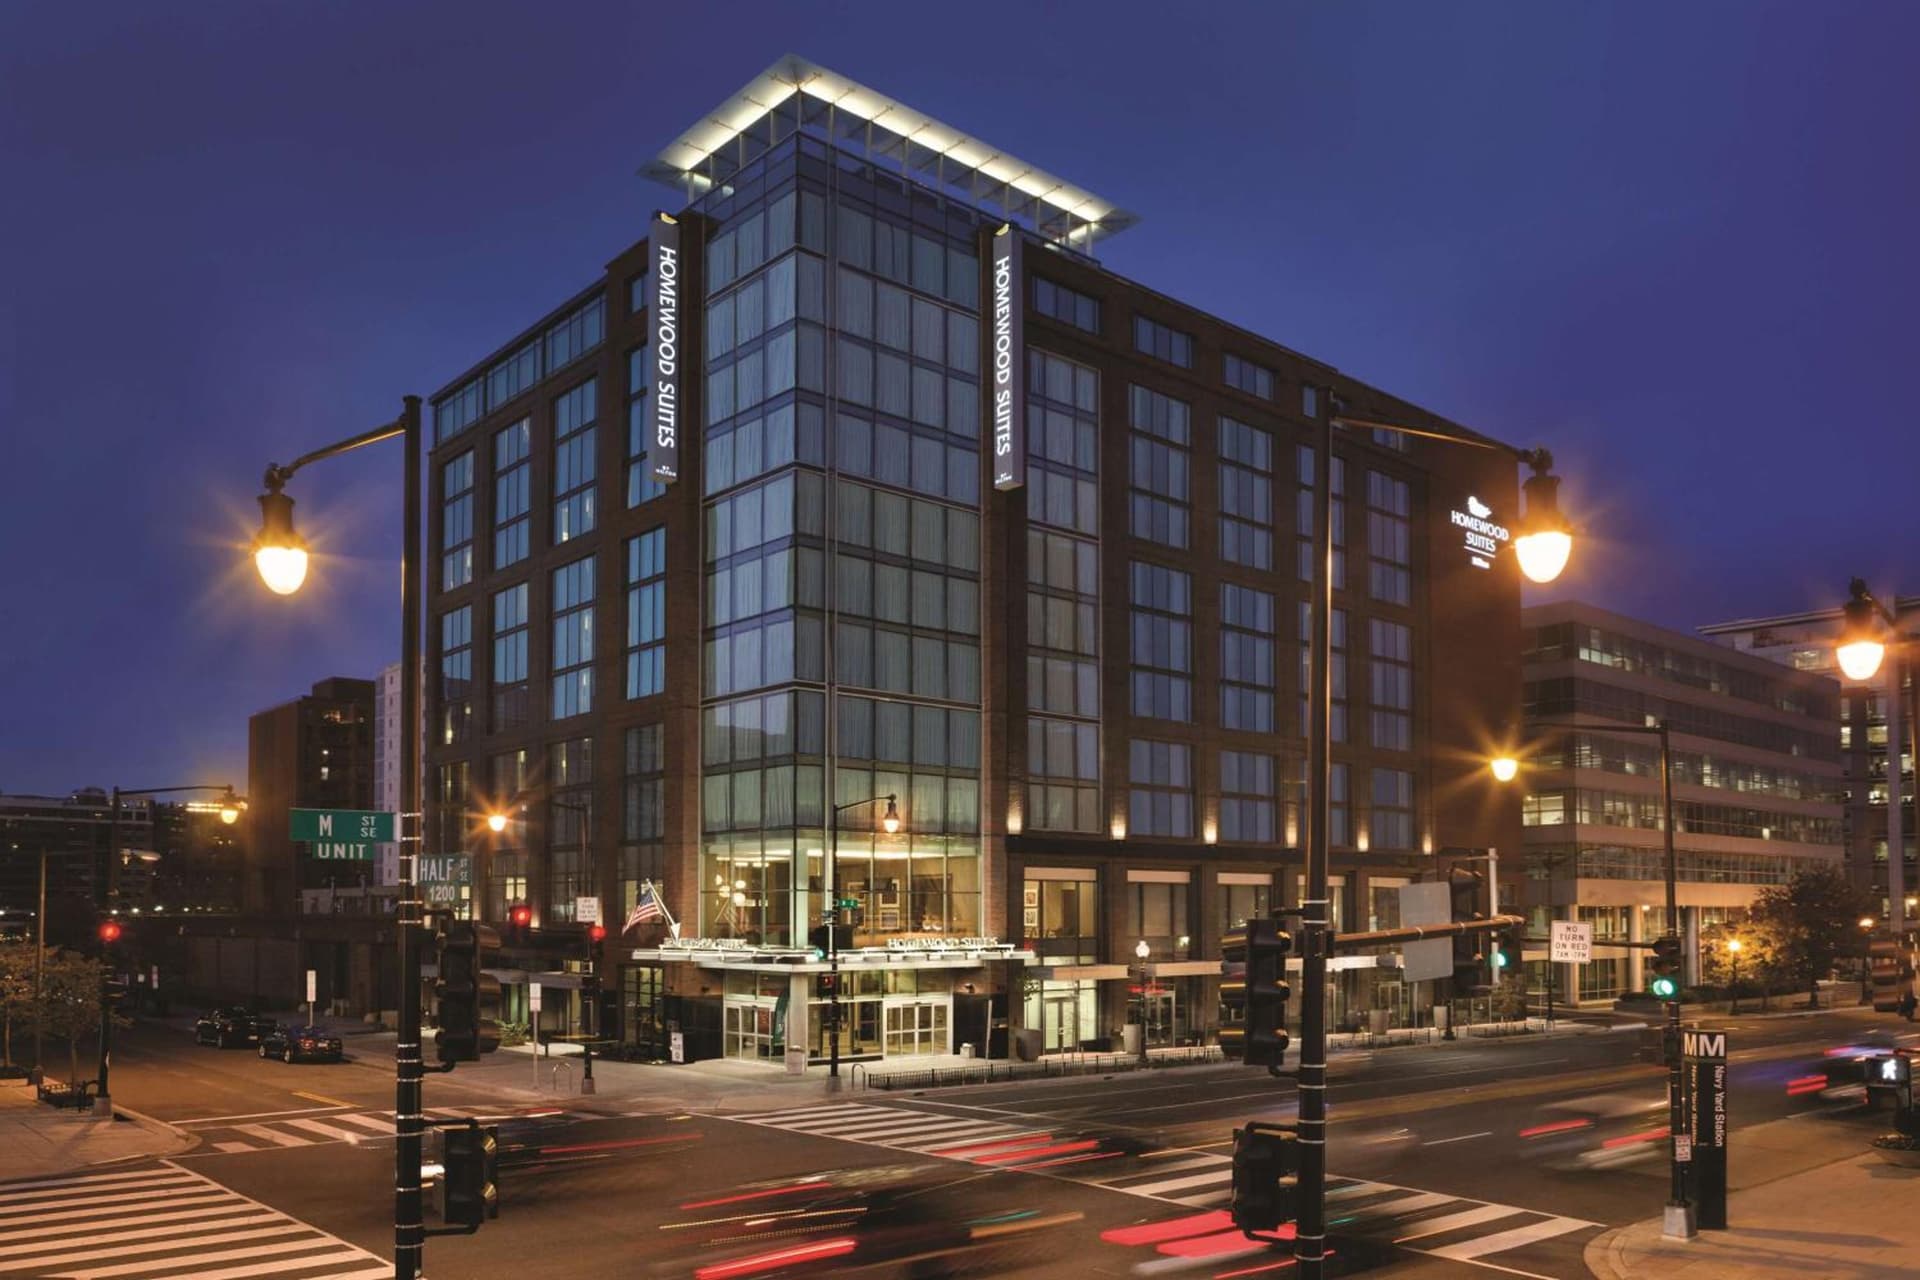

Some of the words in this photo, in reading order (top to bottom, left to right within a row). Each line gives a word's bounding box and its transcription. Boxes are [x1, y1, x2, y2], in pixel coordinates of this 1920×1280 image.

[659, 245, 677, 376] HOMEWOOD
[996, 256, 1010, 384] HOMEWOOD
[658, 380, 676, 448] SUITES
[997, 390, 1010, 454] SUITES
[1451, 510, 1509, 541] HOMEWOOD
[1465, 531, 1496, 552] SUITES
[319, 814, 332, 837] M
[361, 816, 376, 826] ST
[360, 827, 376, 838] SE
[318, 843, 367, 859] UNIT
[420, 859, 454, 881] HALF
[460, 870, 468, 881] SE
[429, 885, 455, 900] 1200
[1556, 942, 1567, 950] ON
[1571, 943, 1588, 951] RED
[1560, 933, 1585, 941] TURN
[1684, 1032, 1697, 1056] M
[1699, 1034, 1725, 1057] M
[1714, 1066, 1725, 1089] Navy
[1714, 1091, 1725, 1112] Yard
[1714, 1113, 1725, 1147] Station
